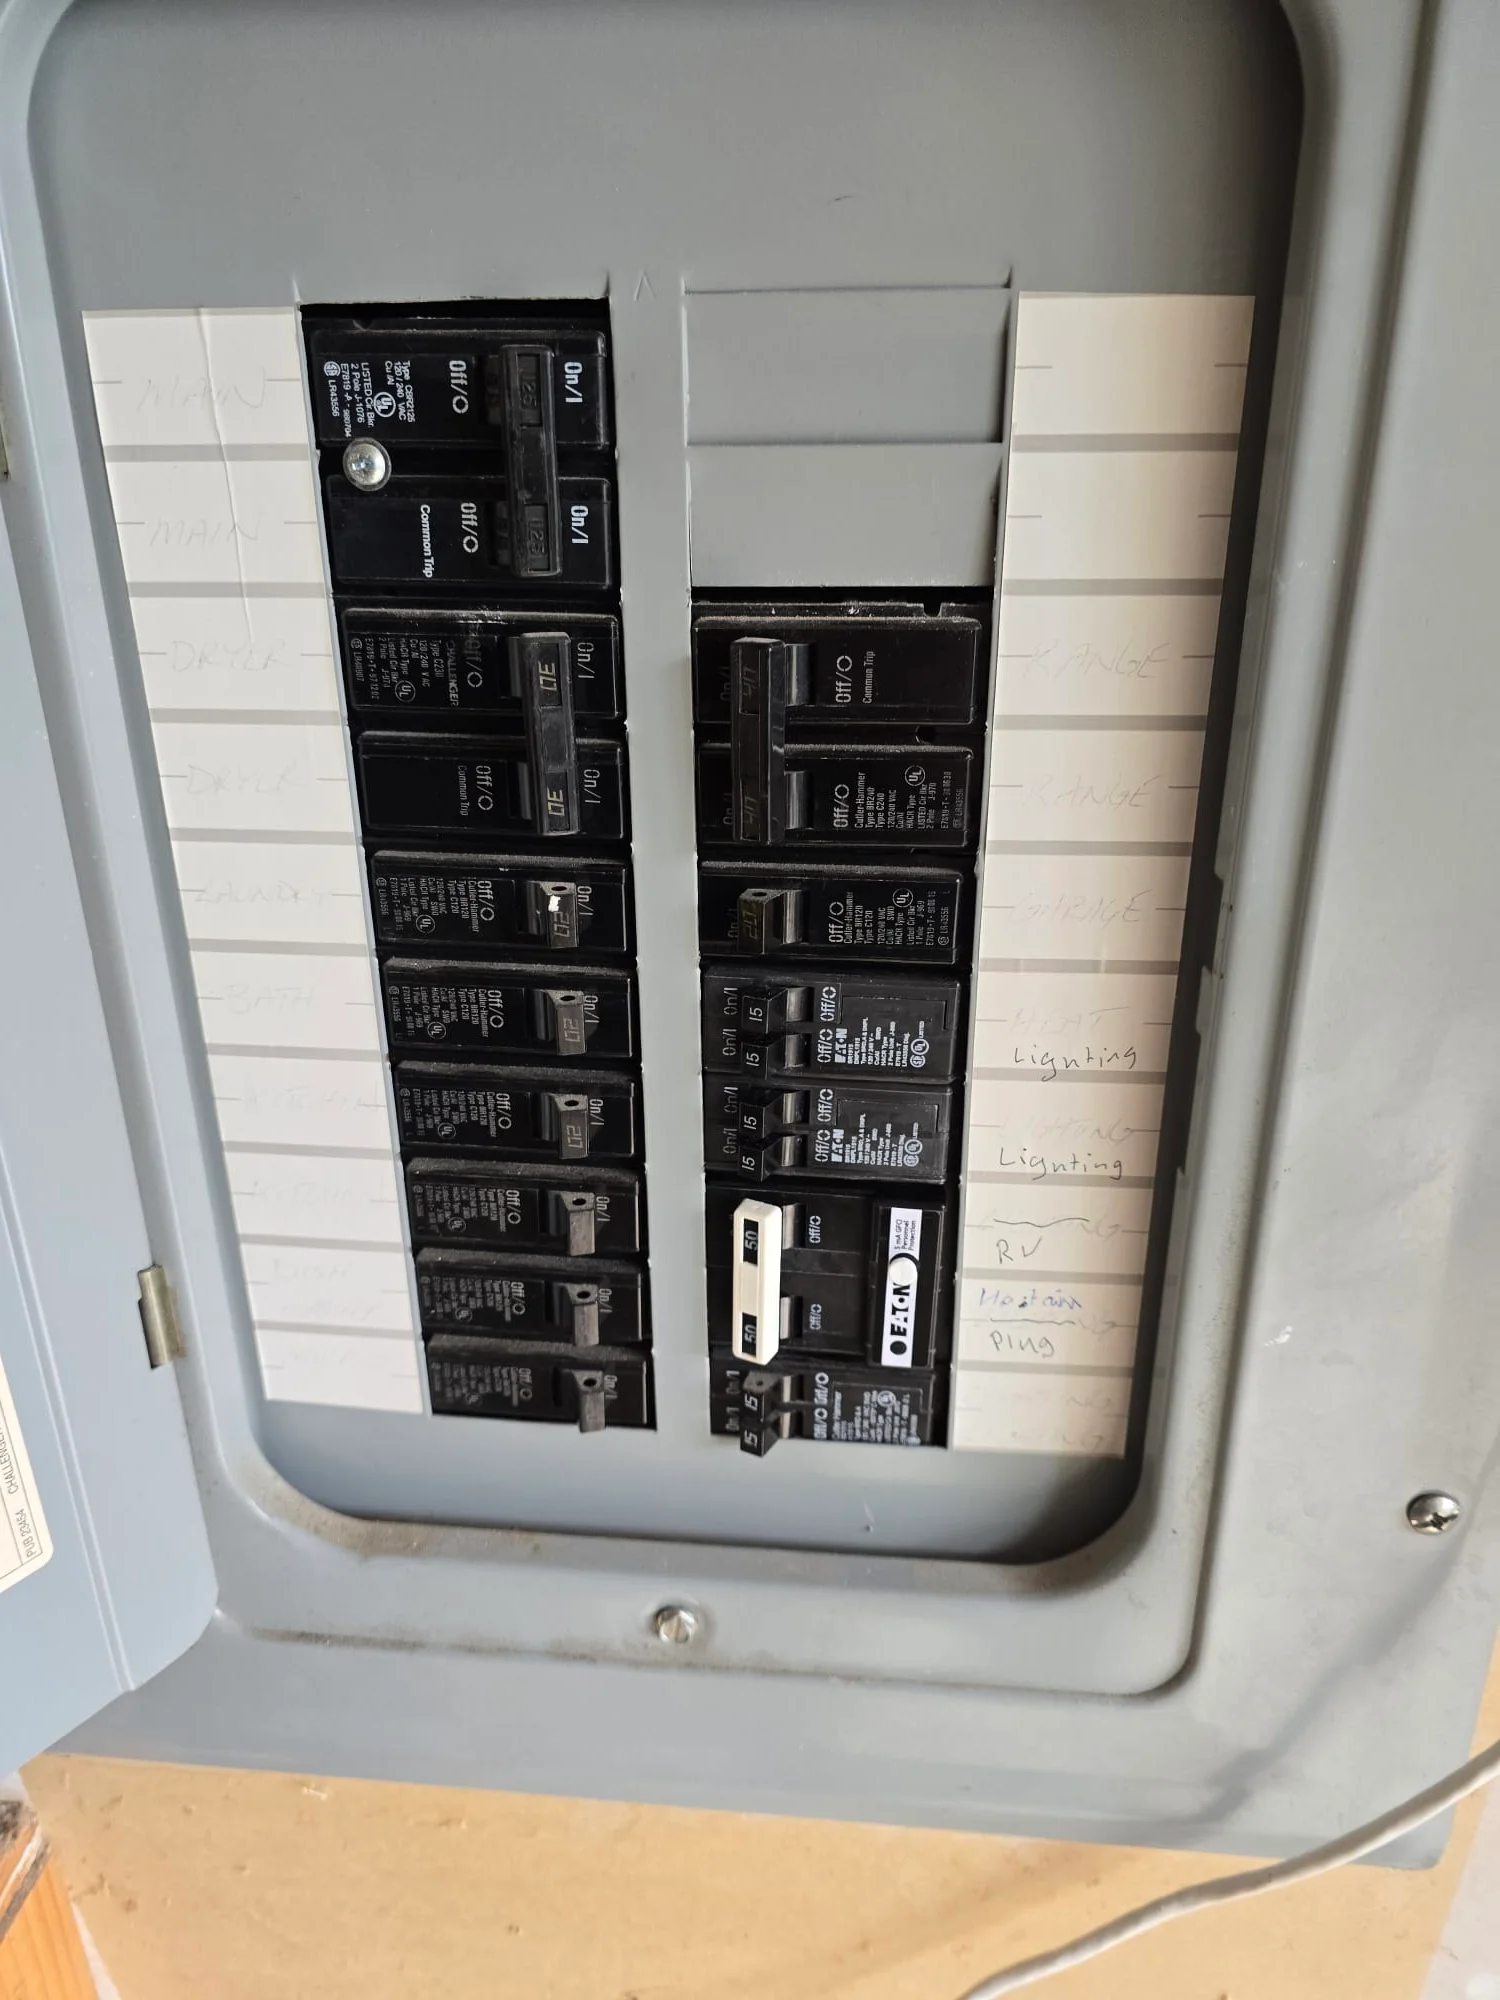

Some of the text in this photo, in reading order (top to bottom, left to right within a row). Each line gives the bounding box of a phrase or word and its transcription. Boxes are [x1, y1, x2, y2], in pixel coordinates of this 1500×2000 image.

[352, 372, 361, 391] Pole
[361, 362, 372, 396] LISTED
[396, 383, 404, 397] 240
[401, 360, 415, 422] Type CBR2125
[449, 360, 469, 414] Off/O
[564, 362, 582, 403] On/I
[328, 380, 339, 417] LR43556
[341, 363, 351, 437] E7819 980704
[355, 394, 364, 423] J-1076
[398, 402, 406, 421] VAC
[420, 504, 435, 578] Common Trip
[460, 502, 479, 553] Off/O
[570, 505, 589, 544] On/I
[171, 639, 296, 673] DRYER
[430, 640, 442, 657] Type
[577, 642, 595, 678] On/I
[446, 640, 459, 707] CHALLENGER
[537, 660, 557, 692] 30
[835, 655, 853, 703] Off/O
[862, 651, 876, 704] Common Trip
[457, 765, 470, 816] Common Trip
[475, 765, 494, 811] Off/O
[547, 787, 564, 816] 30
[583, 769, 601, 804] On/I
[854, 772, 866, 828] Cutler-Hammer
[833, 784, 850, 828] Off/O
[865, 786, 875, 828] Type BR240
[876, 792, 886, 828] Type C240
[456, 880, 467, 896] Type
[477, 880, 495, 921] Off/O
[577, 886, 594, 916] On/I
[828, 902, 844, 943] Off/O
[854, 929, 864, 944] Type
[864, 910, 874, 944] Type C120
[487, 990, 504, 1028] Off/O
[584, 995, 599, 1023] On/I
[723, 987, 738, 1015] On/I
[749, 1007, 763, 1022] 15
[820, 986, 837, 1022] Off/O
[722, 1028, 737, 1056] On/I
[817, 1028, 834, 1063] Off/O
[746, 1052, 760, 1067] 15
[496, 1093, 512, 1129] Off/O
[589, 1099, 604, 1125] On/I
[723, 1086, 738, 1113] On/I
[816, 1088, 834, 1122] Off/O
[743, 1115, 757, 1130] 15
[722, 1128, 737, 1154] On/I
[814, 1129, 831, 1162] Off/O
[741, 1155, 756, 1171] 15
[506, 1190, 521, 1224] Off/O
[596, 1196, 610, 1222] On/I
[744, 1230, 758, 1251] 50
[808, 1215, 822, 1244] Off/O
[901, 1221, 909, 1250] Personnel
[908, 1220, 916, 1250] Protection
[995, 1236, 1043, 1264] RV
[809, 1303, 823, 1330] Off/O
[890, 1282, 911, 1336] EATON
[744, 1324, 757, 1343] 50
[744, 1394, 758, 1411] 15
[744, 1430, 758, 1447] 15
[23, 1537, 38, 1558] PUB
